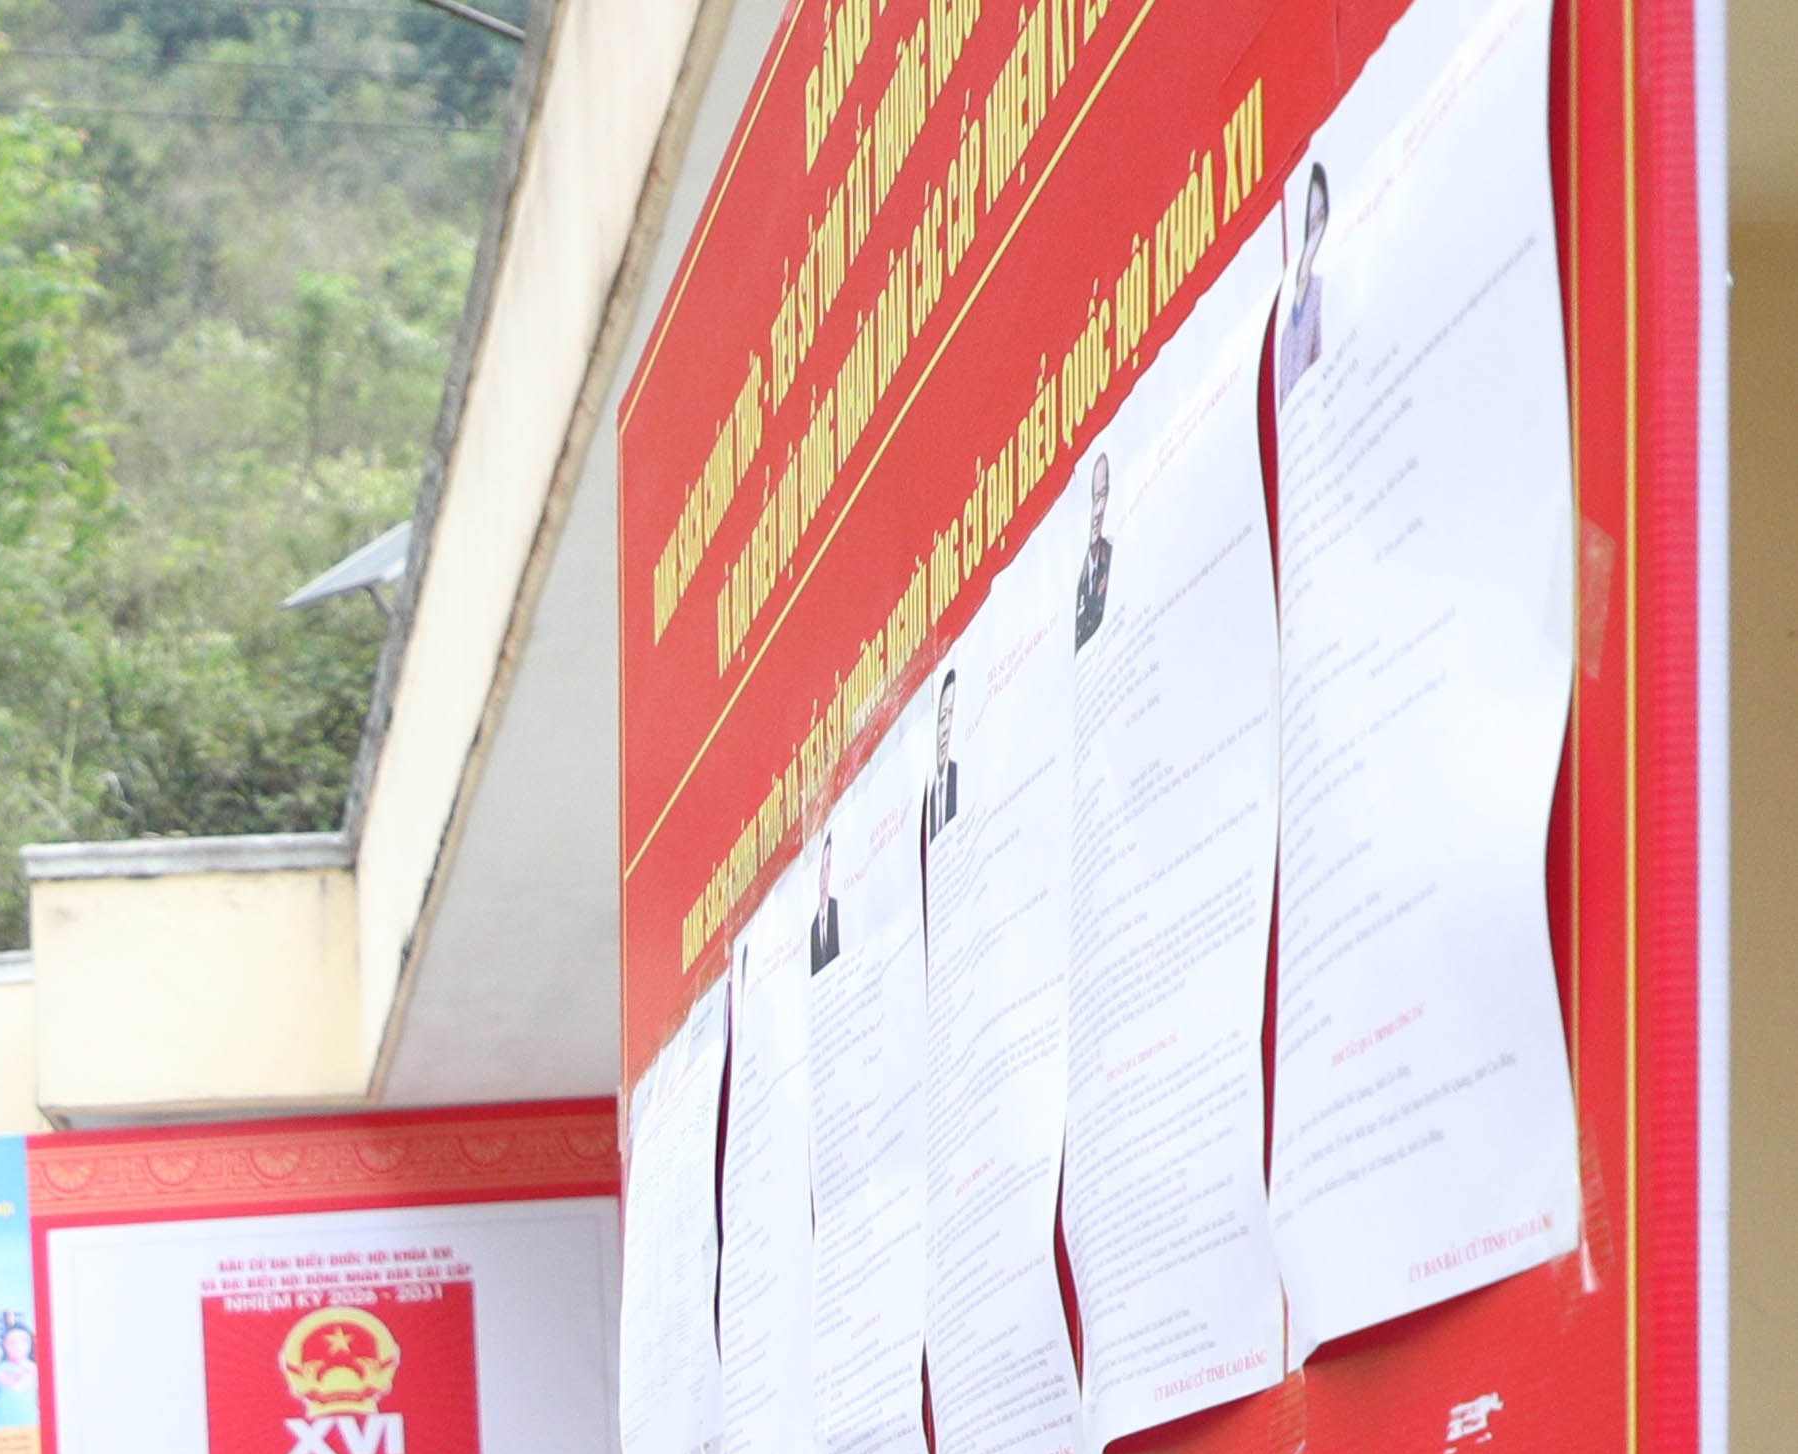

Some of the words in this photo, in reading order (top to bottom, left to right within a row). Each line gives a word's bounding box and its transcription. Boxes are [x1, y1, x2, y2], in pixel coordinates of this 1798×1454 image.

[654, 529, 677, 646] DANH
[679, 483, 703, 598] SÁCH
[705, 412, 734, 548] CHÍNH
[735, 350, 762, 487] THỨC
[771, 256, 795, 415] TIỂU
[799, 213, 816, 364] SỬ
[817, 182, 845, 326] TÓM
[847, 104, 871, 267] TẮT
[875, 18, 925, 216] NHỮNG
[683, 892, 704, 975] DANH
[705, 858, 728, 943] SÁCH
[785, 743, 799, 830] VÀ
[827, 670, 843, 777] SỬ
[844, 629, 885, 754] NHỮNG
[887, 554, 926, 692] NGƯỜI
[931, 518, 960, 626] ỨNG
[963, 457, 986, 580] CỬ
[987, 437, 1013, 551] ĐẠI
[1018, 352, 1057, 507] BIỂU
[1061, 278, 1112, 450] QUỐC
[1115, 233, 1149, 370] HỘI
[1155, 149, 1216, 316] KHÓA
[1223, 77, 1264, 227] XVI
[718, 562, 731, 678] VÀ
[732, 542, 750, 661] ĐẠI
[752, 465, 777, 621] BIỂU
[779, 441, 798, 580] HỘI
[800, 384, 834, 536] ĐỒNG
[837, 309, 874, 473] NHÂN
[878, 248, 907, 401] DÂN
[912, 180, 942, 339] CÁC
[947, 88, 981, 277] CẤP
[986, 0, 1046, 215] NHIỆM
[223, 1288, 292, 1314] NHIỆM
[396, 1283, 444, 1303] 2031
